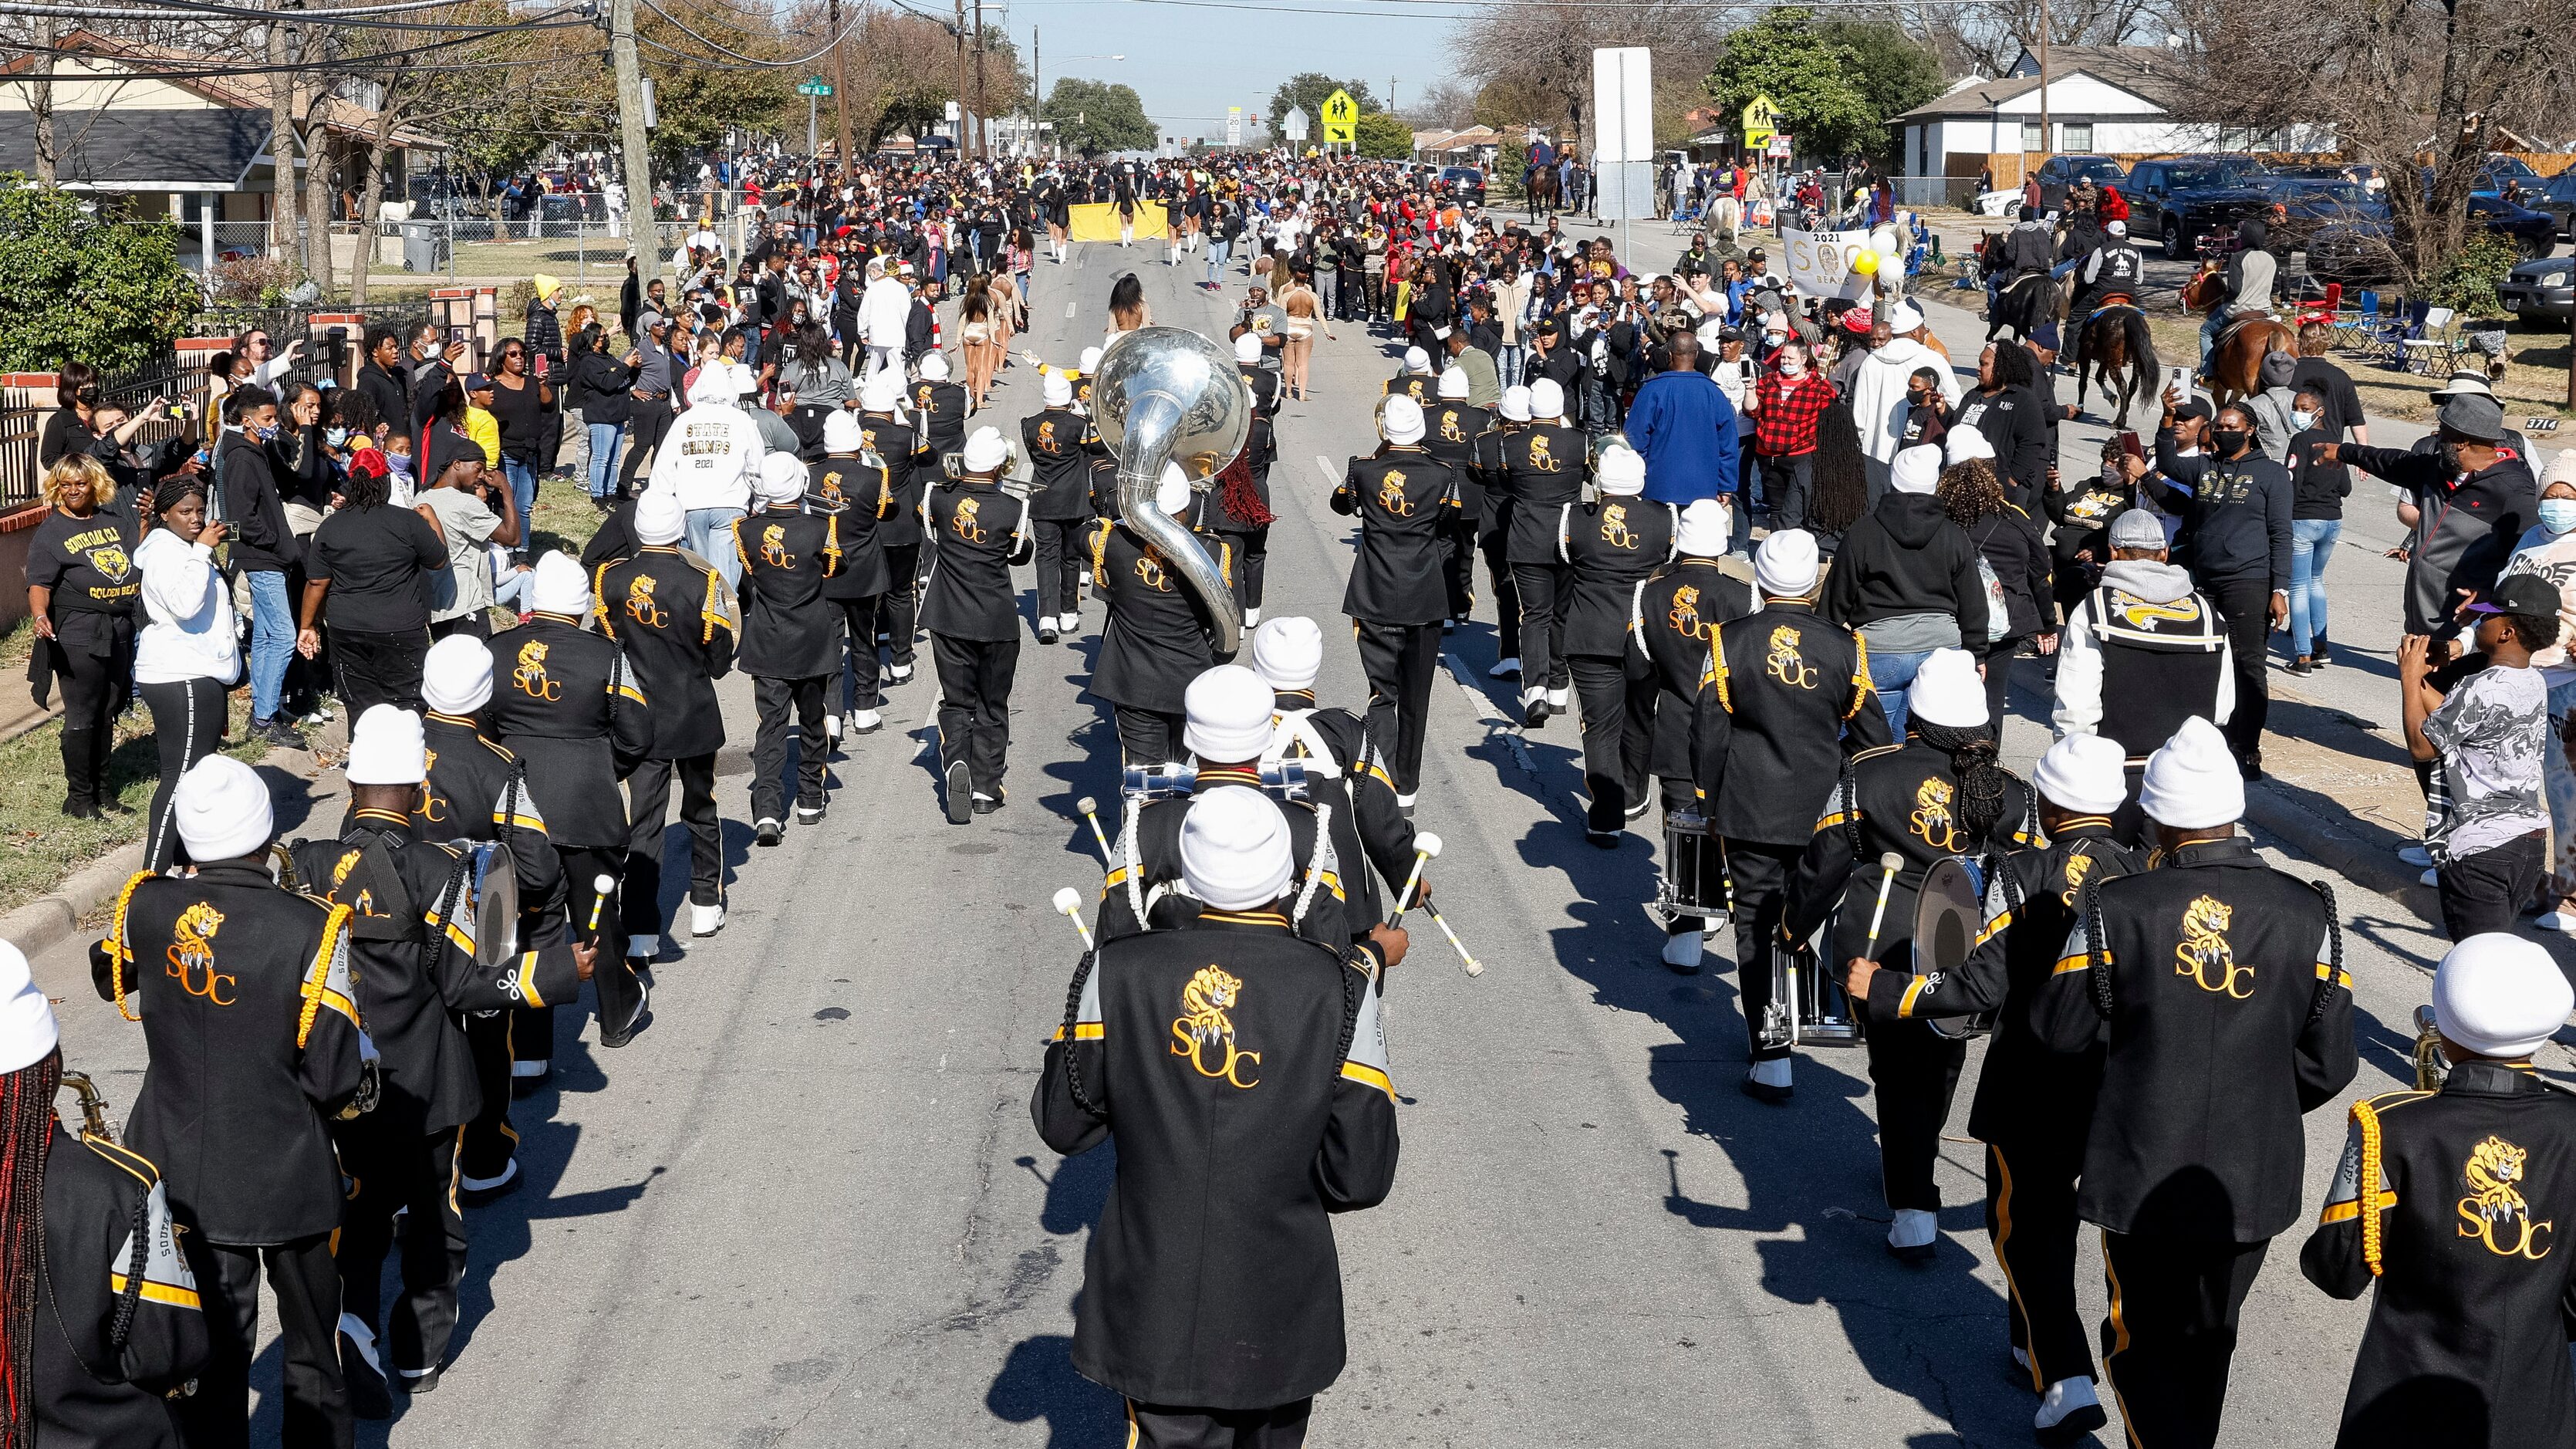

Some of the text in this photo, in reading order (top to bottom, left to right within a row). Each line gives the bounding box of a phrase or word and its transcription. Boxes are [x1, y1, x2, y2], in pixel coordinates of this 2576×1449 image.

[798, 85, 819, 94] Garza
[1813, 233, 1841, 243] 2021
[1816, 275, 1850, 286] BEARS
[1998, 400, 2014, 411] KMG
[686, 423, 730, 437] STATE
[1440, 424, 1467, 444] SOC
[2527, 418, 2558, 431] 3714
[681, 440, 731, 456] CHAMPS
[1037, 434, 1062, 454] SOC
[695, 459, 713, 468] 2021
[1529, 452, 1562, 472] SOC
[1379, 490, 1415, 517] SOC
[63, 532, 92, 555] SOUTH
[87, 529, 108, 545] OAK
[952, 516, 987, 544] SOC
[1601, 525, 1640, 550] SOC
[761, 545, 796, 569] SOC
[1134, 557, 1173, 593] SOC
[89, 586, 120, 600] GOLDEN
[626, 598, 669, 629] SOC
[513, 667, 562, 701] SOC
[1766, 654, 1818, 689] SOC
[1909, 810, 1969, 853] SOC
[338, 944, 346, 974] SOUTH
[2175, 941, 2255, 1001] SOC
[166, 944, 236, 1005] SOC
[1170, 1016, 1261, 1089] SOC
[2343, 1147, 2354, 1185] CLIFF
[160, 1217, 170, 1258] SOUTH
[2457, 1196, 2552, 1260] SOC
